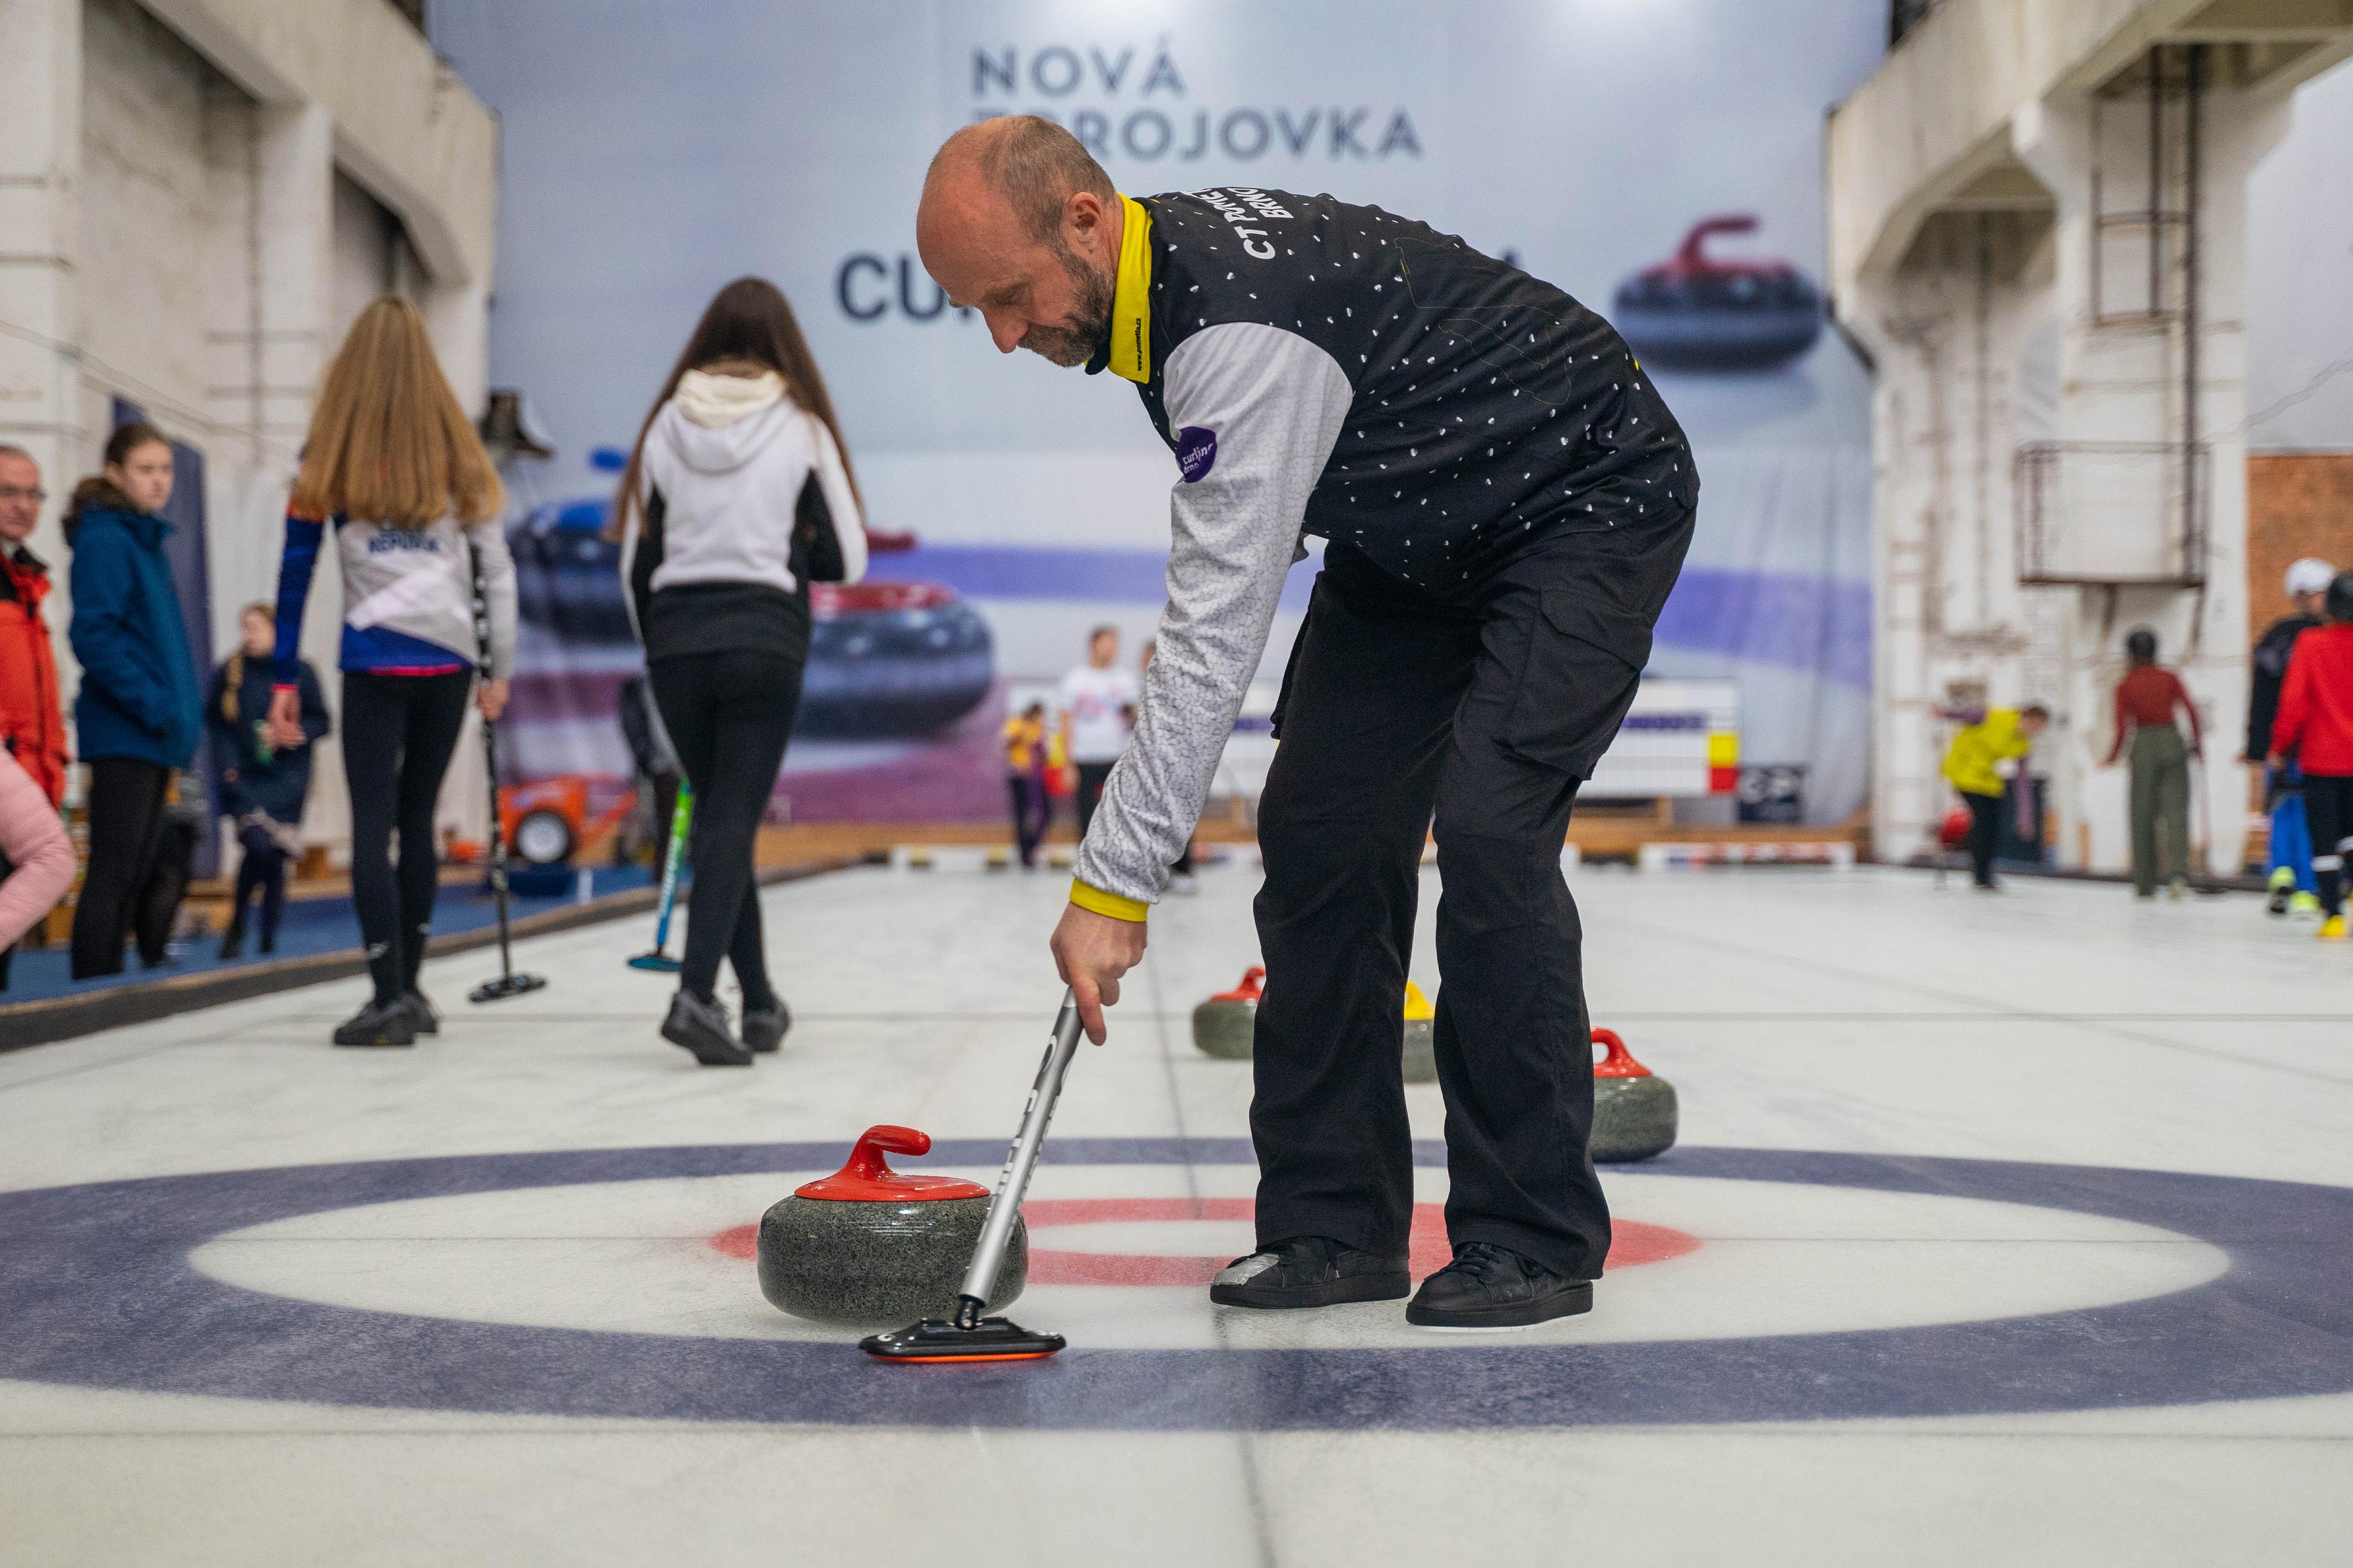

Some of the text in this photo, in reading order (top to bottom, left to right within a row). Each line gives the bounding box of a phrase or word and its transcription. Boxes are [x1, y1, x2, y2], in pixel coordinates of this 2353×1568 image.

[971, 36, 1185, 96] NOVÁ
[974, 108, 1422, 161] ROJOVKA
[1227, 188, 1294, 218] BRNO
[1234, 226, 1275, 259] CT
[835, 252, 974, 322] CU
[1184, 462, 1199, 473] brno
